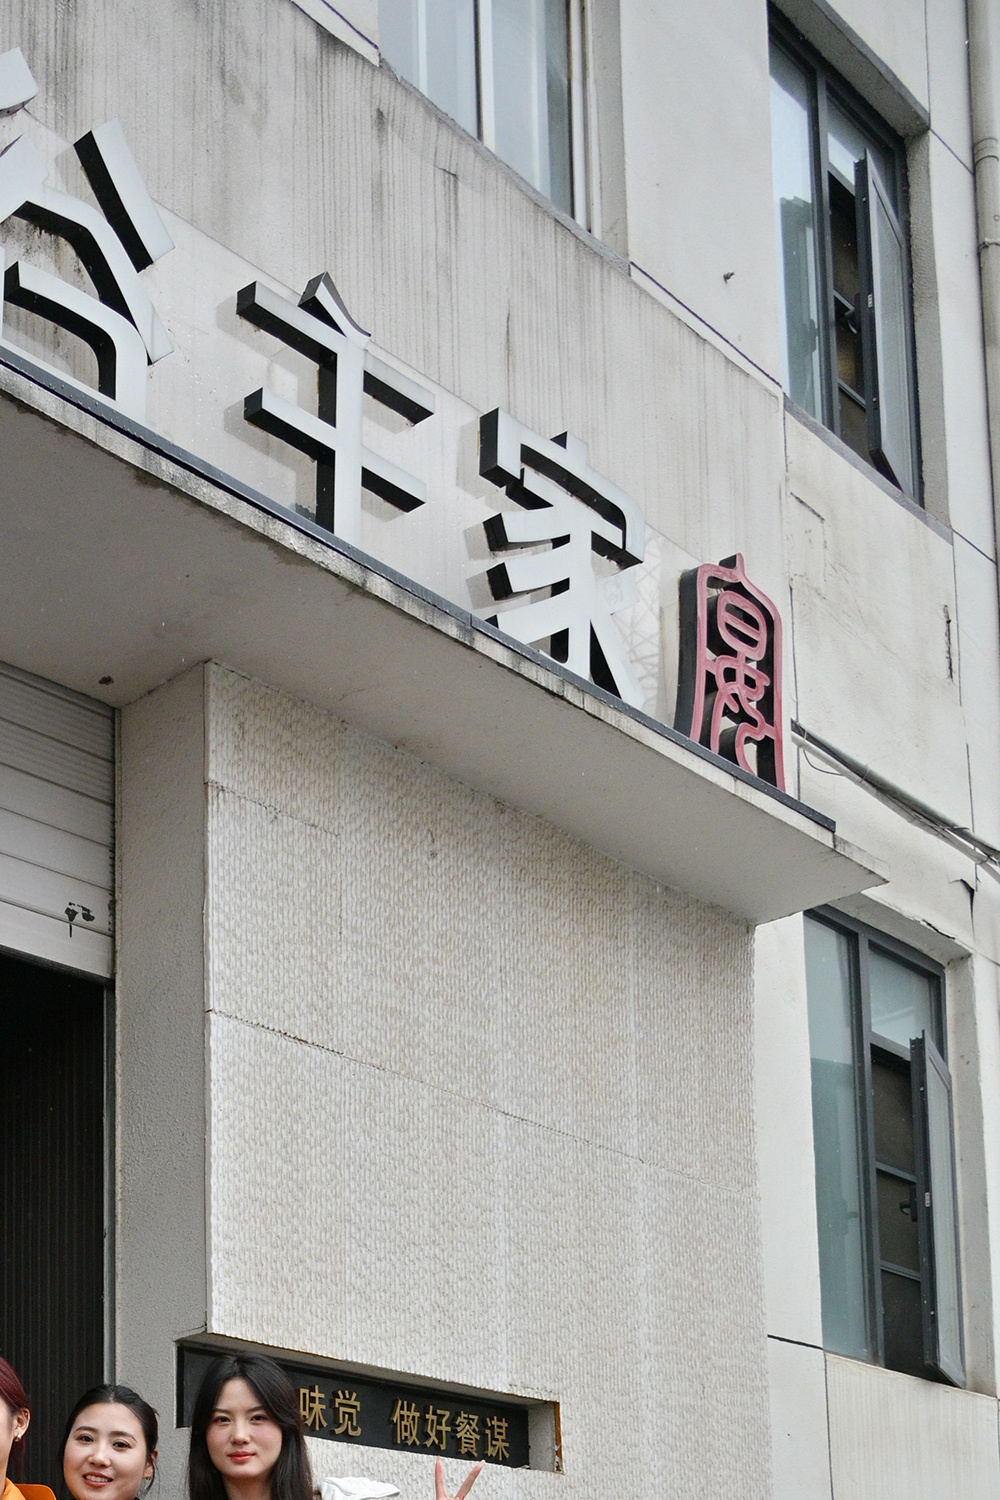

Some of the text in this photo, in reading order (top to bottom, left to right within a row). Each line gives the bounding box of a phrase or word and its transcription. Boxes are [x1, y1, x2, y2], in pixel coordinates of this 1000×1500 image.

[300, 1384, 510, 1462] 味觉 做好餐谋
